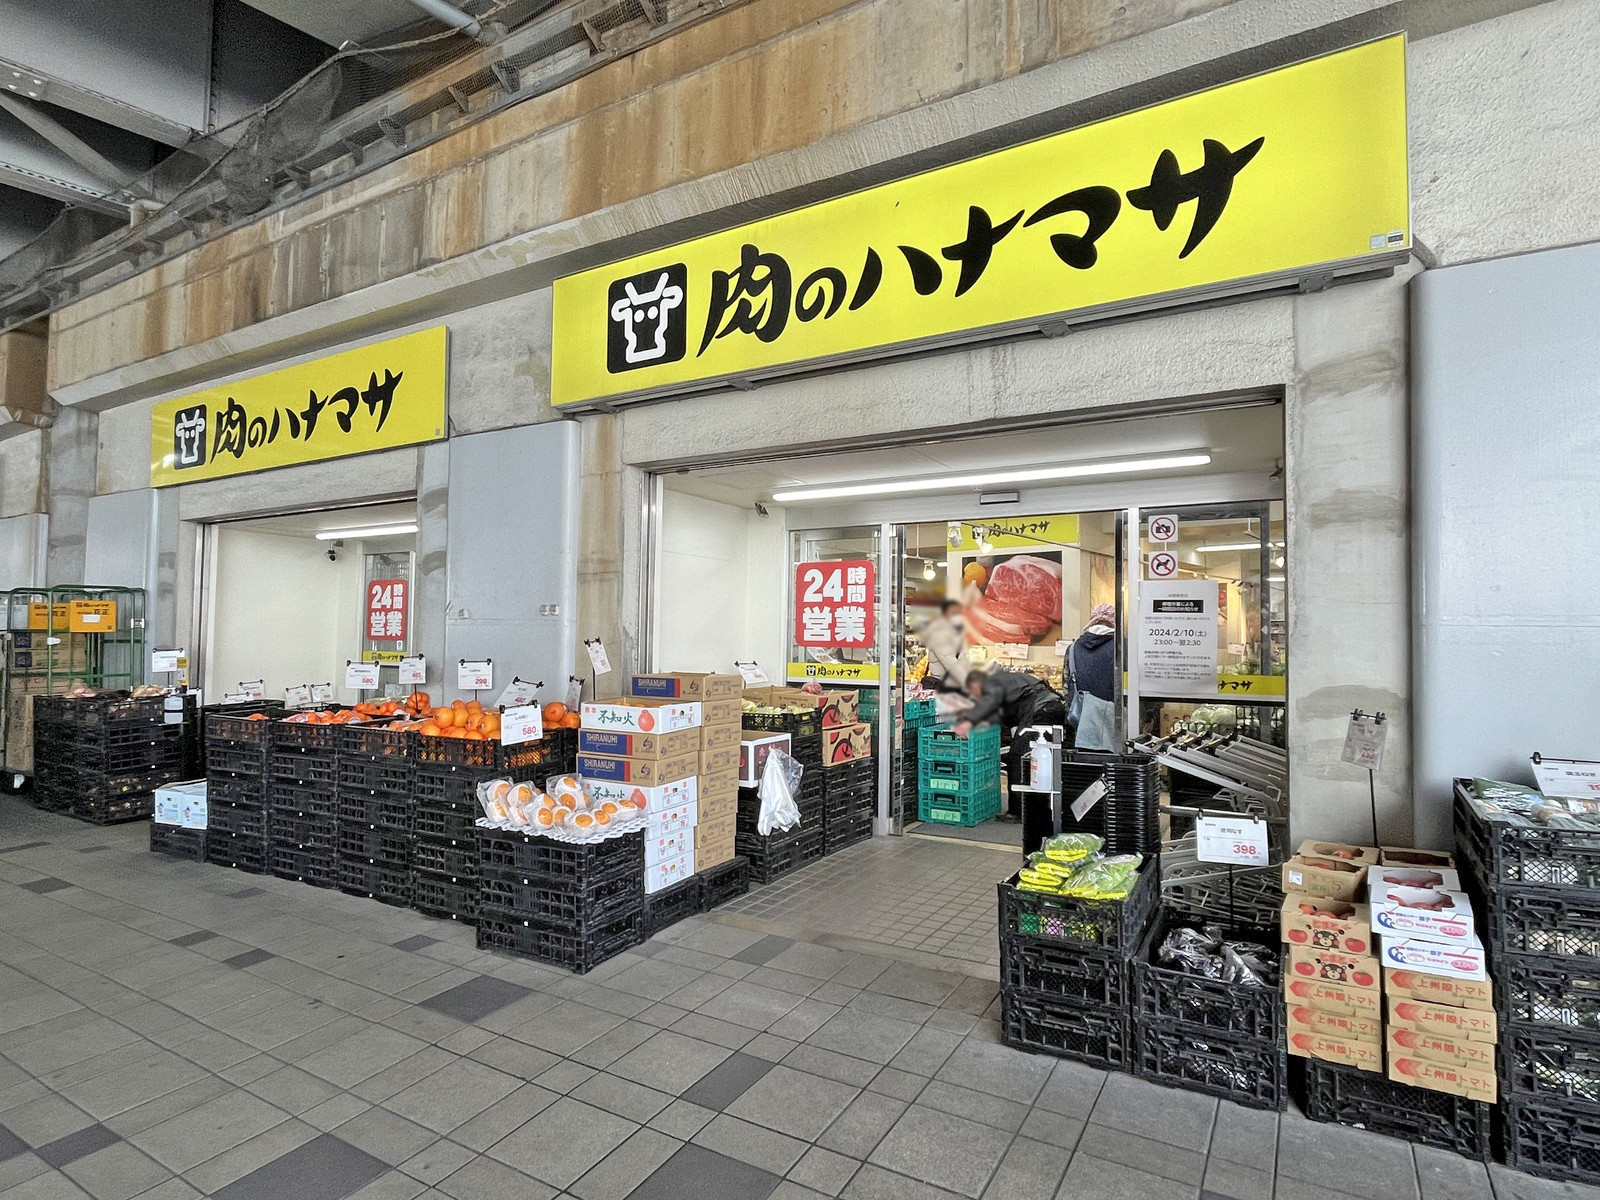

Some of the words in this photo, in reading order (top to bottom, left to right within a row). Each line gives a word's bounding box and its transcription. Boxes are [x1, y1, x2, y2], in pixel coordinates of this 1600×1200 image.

[697, 136, 1265, 357] 肉のハナマサ
[210, 369, 403, 464] 肉のハナマサ
[371, 611, 403, 636] 営業
[802, 606, 867, 643] 営業
[817, 666, 861, 677] 肉のハナマサ
[637, 678, 667, 688] SHIRANUHI
[598, 709, 635, 726] 不知火
[522, 726, 537, 735] 580
[586, 733, 618, 743] SHIRANUHI
[583, 759, 616, 769] SHIRANUHI
[1233, 844, 1257, 855] 398
